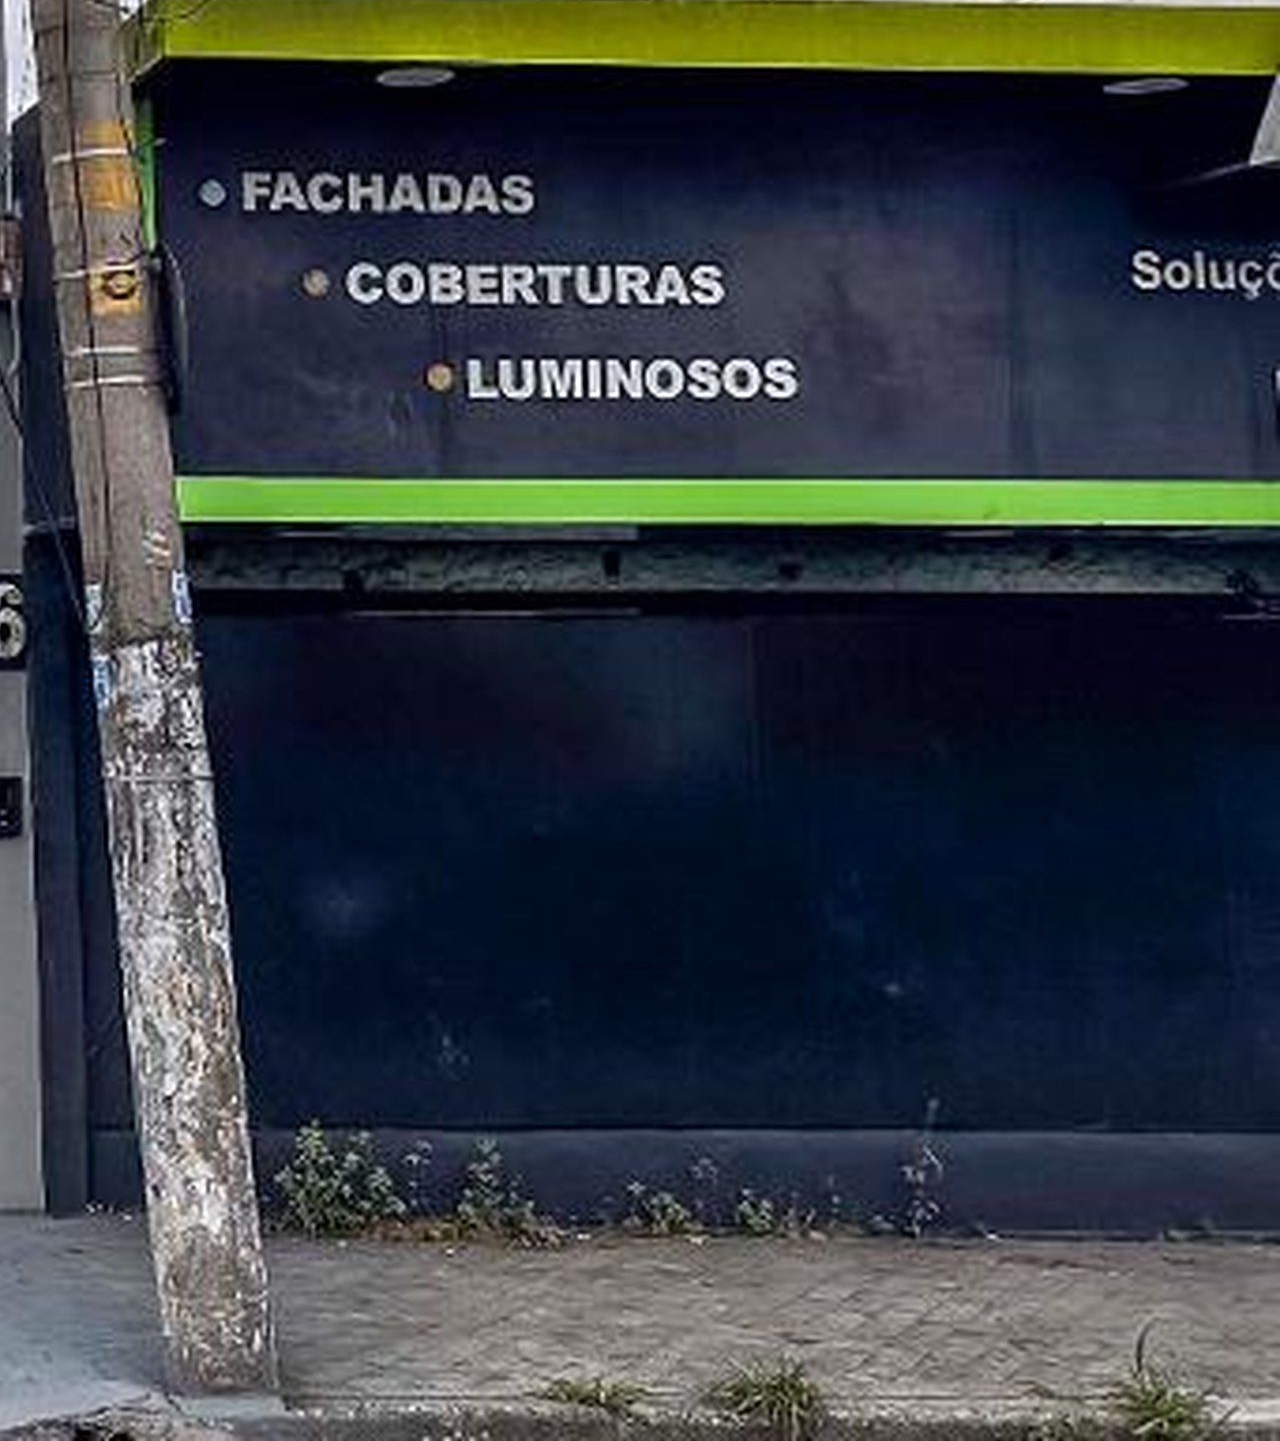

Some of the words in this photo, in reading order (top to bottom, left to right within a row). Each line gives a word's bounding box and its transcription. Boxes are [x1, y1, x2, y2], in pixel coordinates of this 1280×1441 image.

[242, 172, 535, 214] FACHADAS
[345, 261, 727, 306] COBERTURAS
[466, 357, 800, 401] LUMINOSOS
